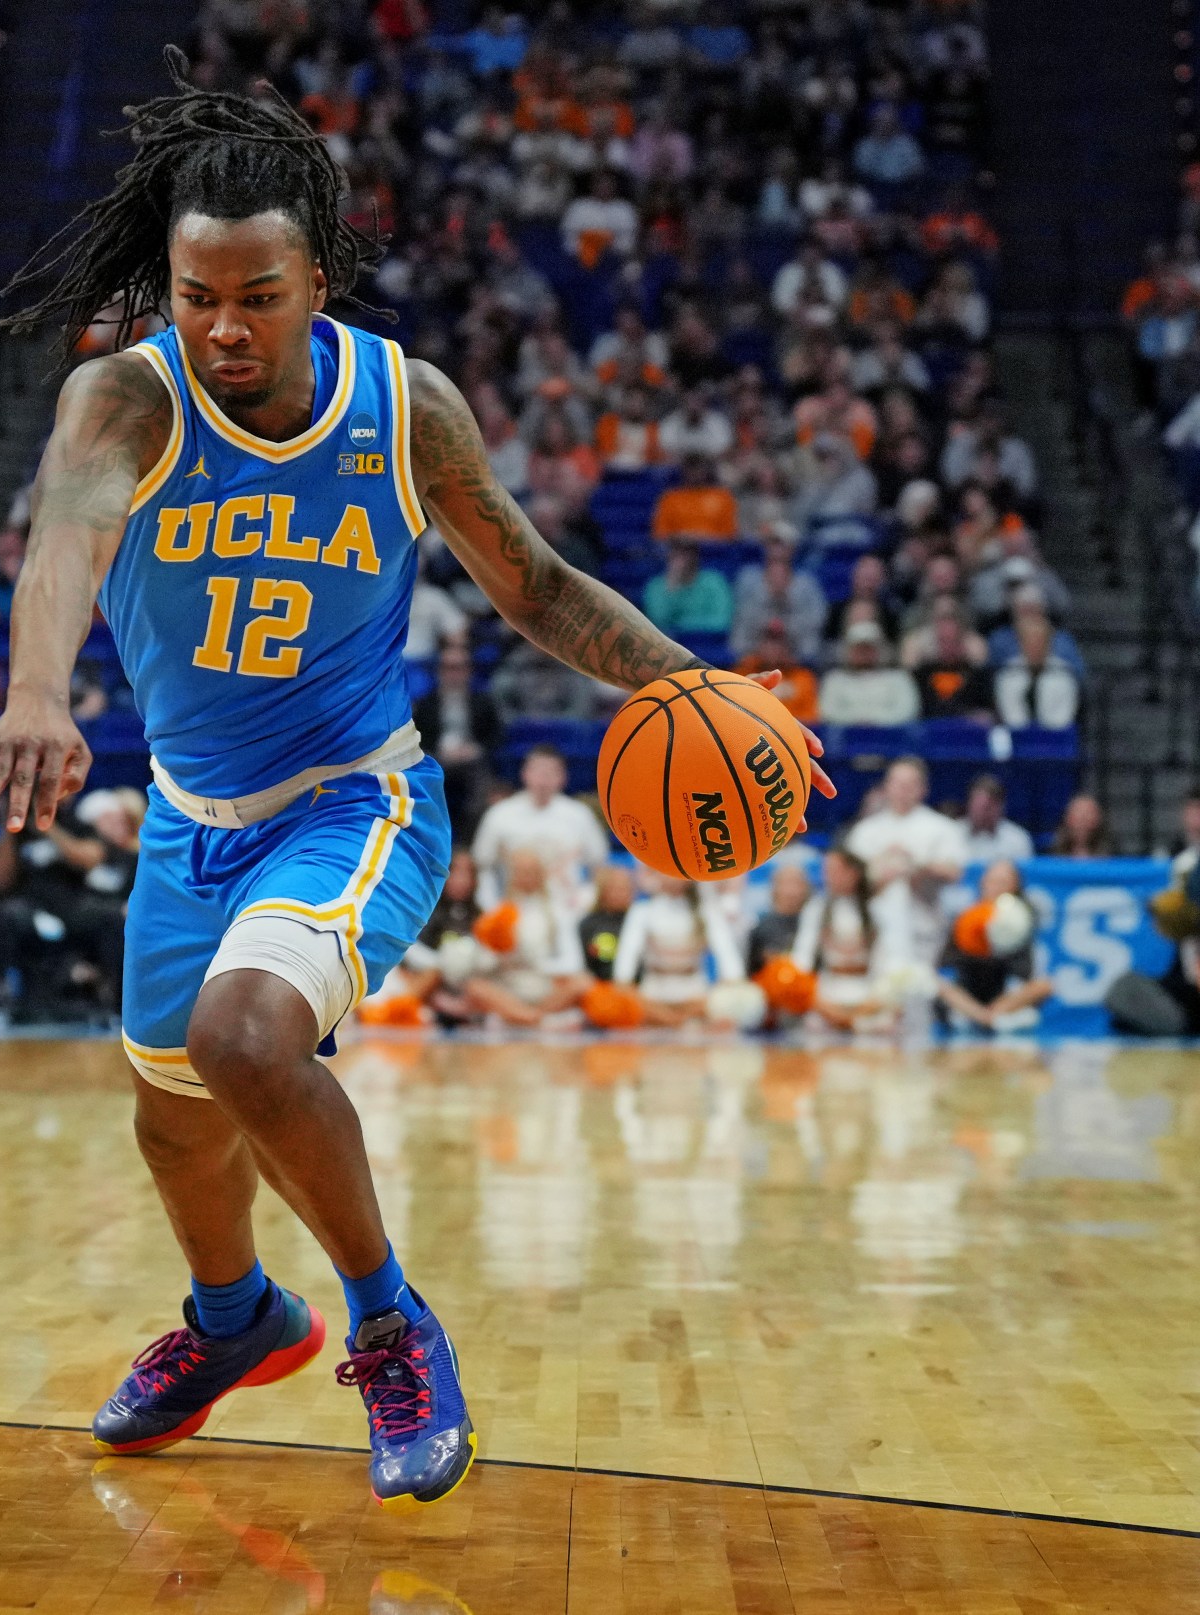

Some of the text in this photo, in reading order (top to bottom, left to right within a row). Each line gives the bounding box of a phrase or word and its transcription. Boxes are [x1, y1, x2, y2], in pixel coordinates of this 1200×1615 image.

[351, 428, 376, 438] NCAA
[153, 493, 381, 575] UCLA
[192, 576, 313, 679] 12
[682, 792, 694, 833] OFFICIAL
[691, 835, 701, 859] GAME
[691, 791, 737, 873] NCAA
[758, 803, 767, 821] EVO
